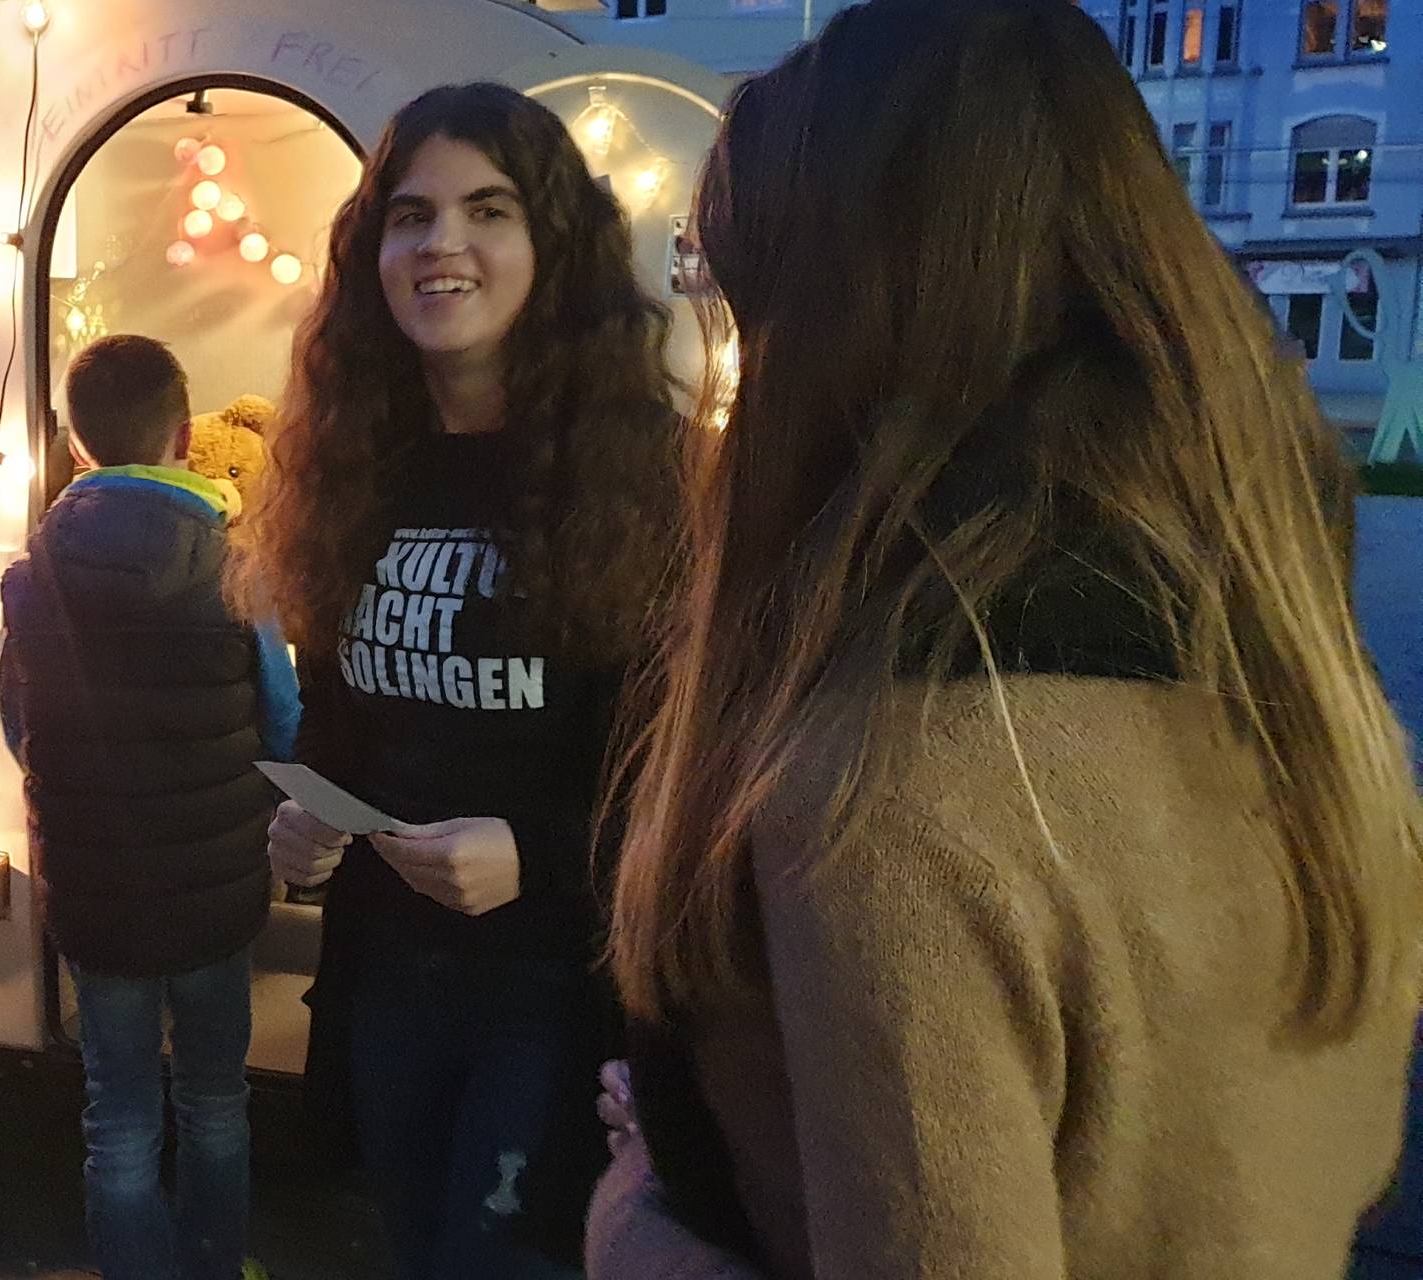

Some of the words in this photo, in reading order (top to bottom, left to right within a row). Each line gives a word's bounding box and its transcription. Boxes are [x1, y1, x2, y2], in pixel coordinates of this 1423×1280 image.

[270, 31, 380, 92] FREI
[375, 541, 511, 599] KULTU
[338, 583, 465, 653] ACHT
